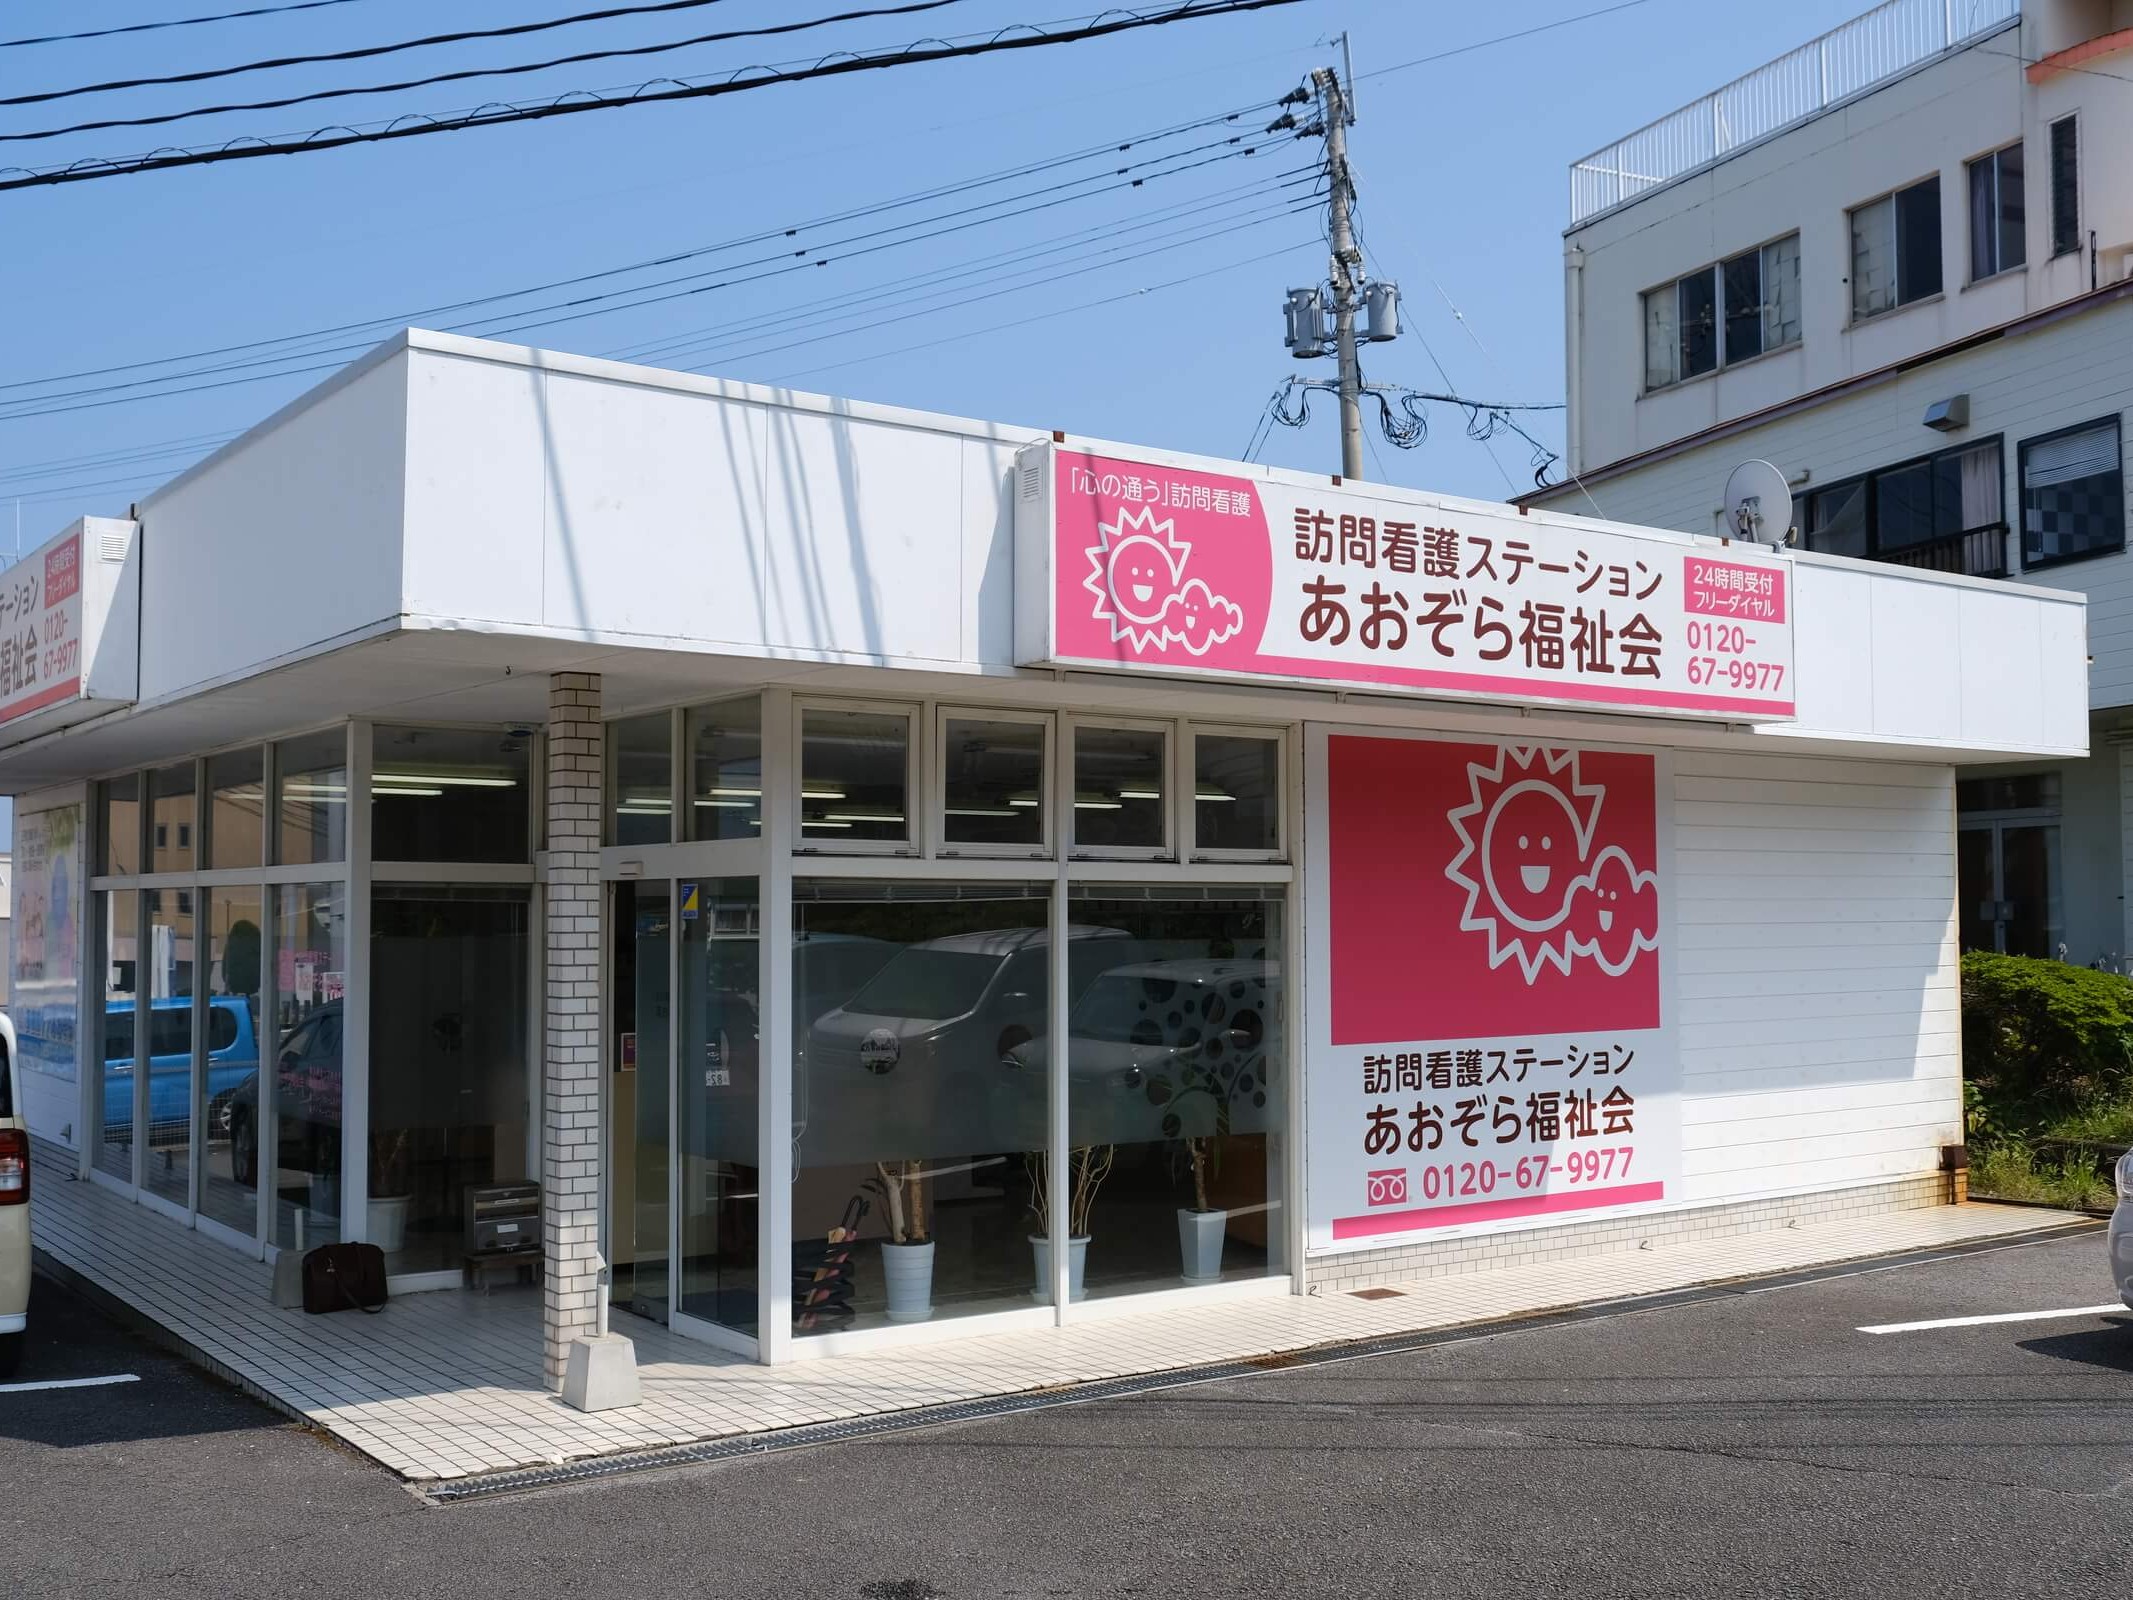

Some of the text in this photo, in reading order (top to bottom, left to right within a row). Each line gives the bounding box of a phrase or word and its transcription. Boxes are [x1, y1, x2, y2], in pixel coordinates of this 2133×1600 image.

[1071, 467, 1251, 517] 「心の通う」訪問看護
[1294, 507, 1663, 601] 訪問看護ステーション
[1693, 564, 1774, 596] 24時間受付
[1693, 590, 1775, 617] フリーダイヤル
[1299, 574, 1663, 680] あおぞら福祉会
[1687, 621, 1756, 653] 0120-
[1687, 656, 1784, 692] 67-9977
[1363, 1044, 1634, 1095] 訪問看護ステーション
[1364, 1085, 1634, 1155] あおぞら福祉会
[1423, 1146, 1635, 1200] 0120-67-9977
